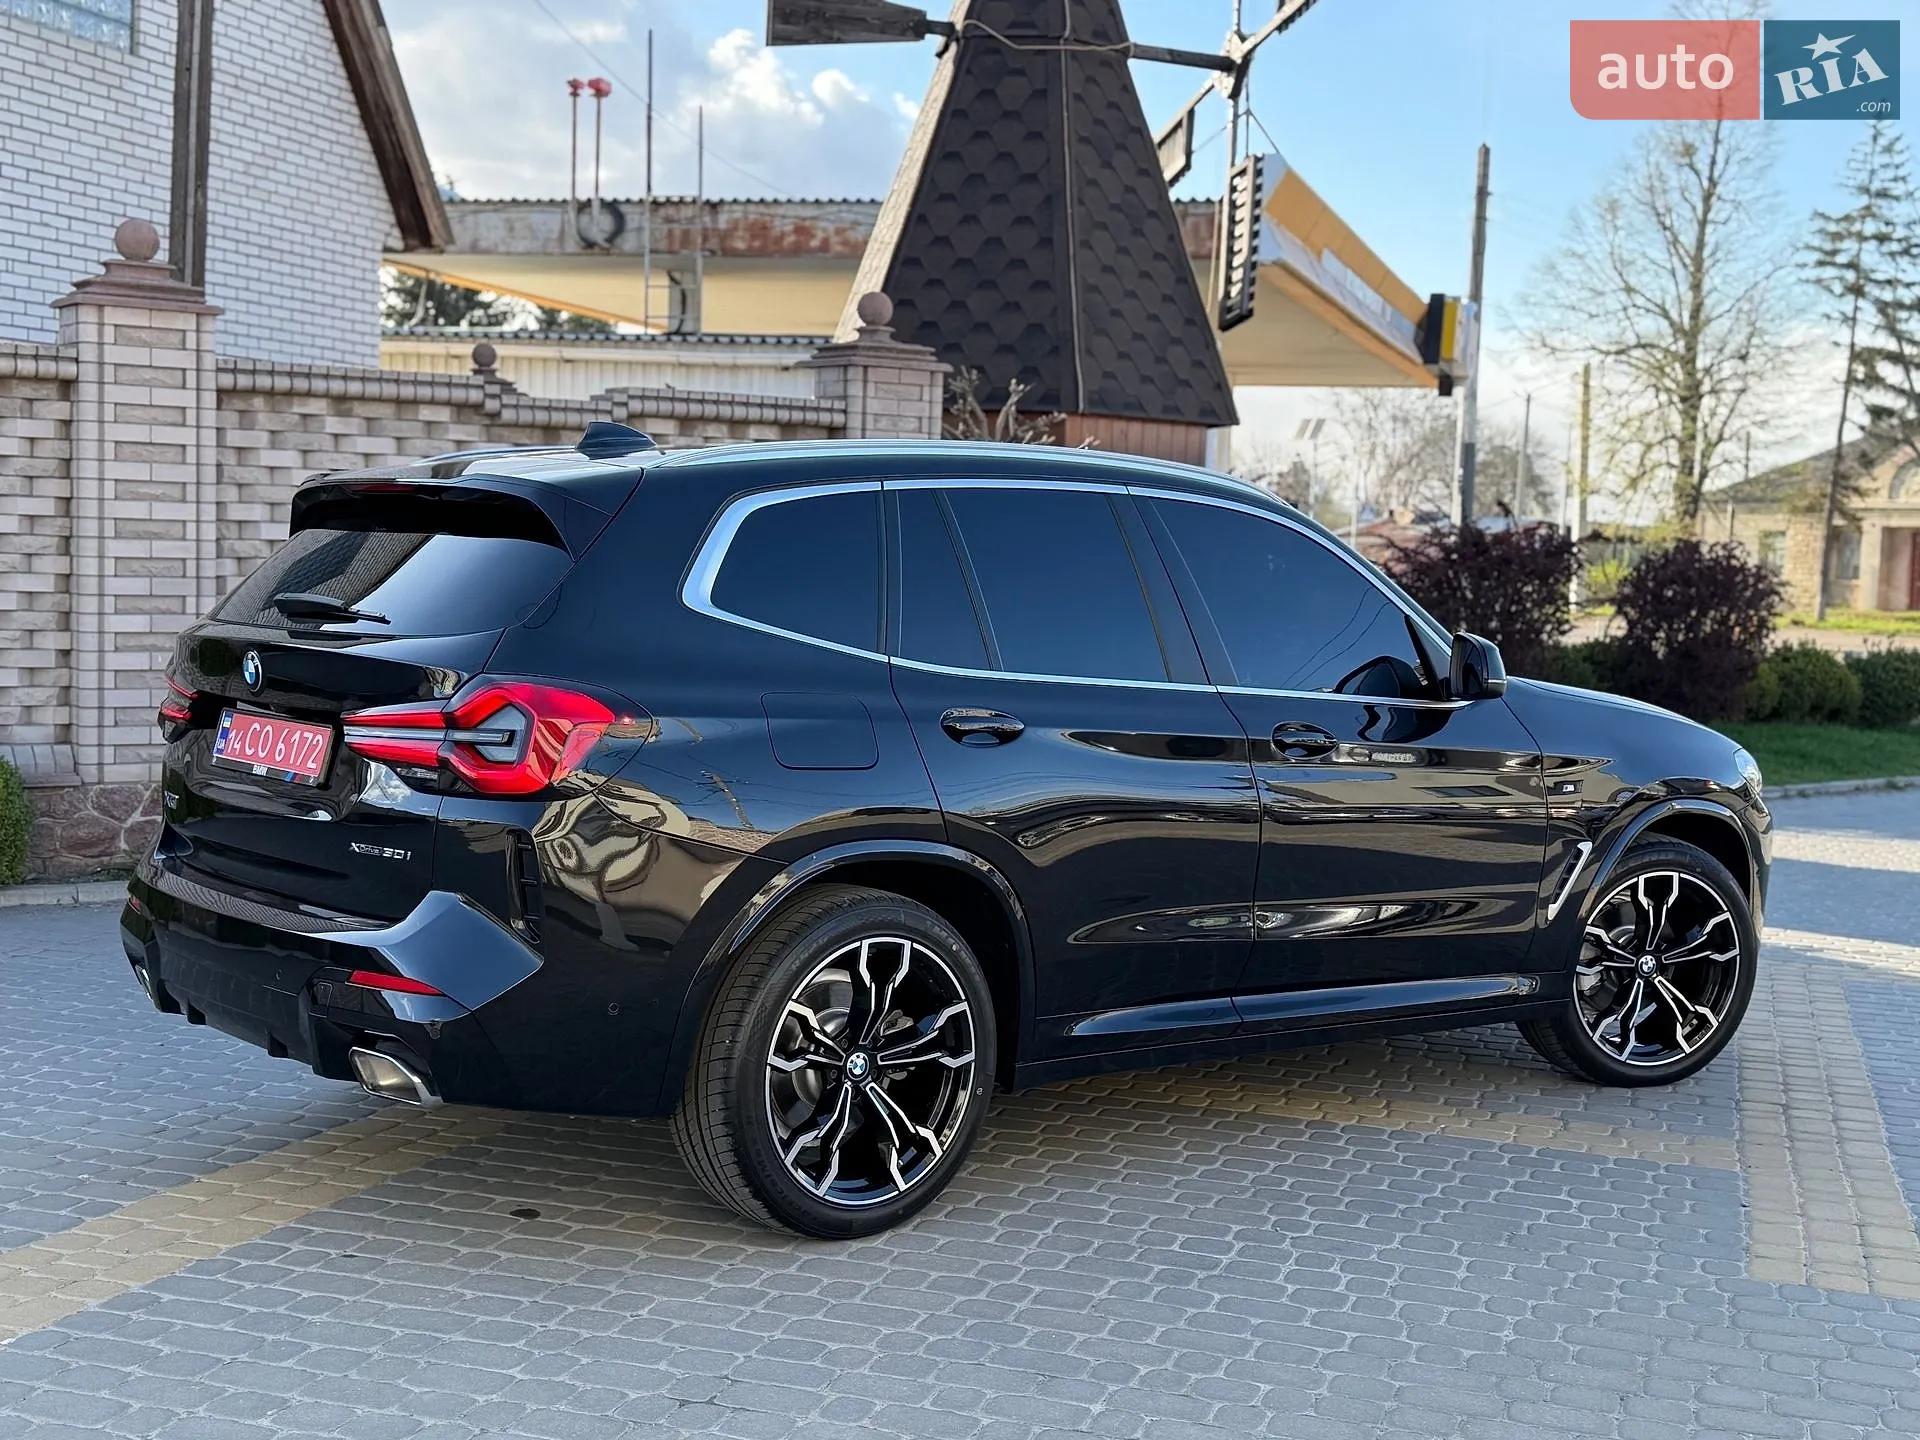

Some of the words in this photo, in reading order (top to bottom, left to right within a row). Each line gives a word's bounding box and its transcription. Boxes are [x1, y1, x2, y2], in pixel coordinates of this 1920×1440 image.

[228, 729, 244, 755] 14
[245, 722, 273, 758] CO
[275, 728, 323, 769] 6172
